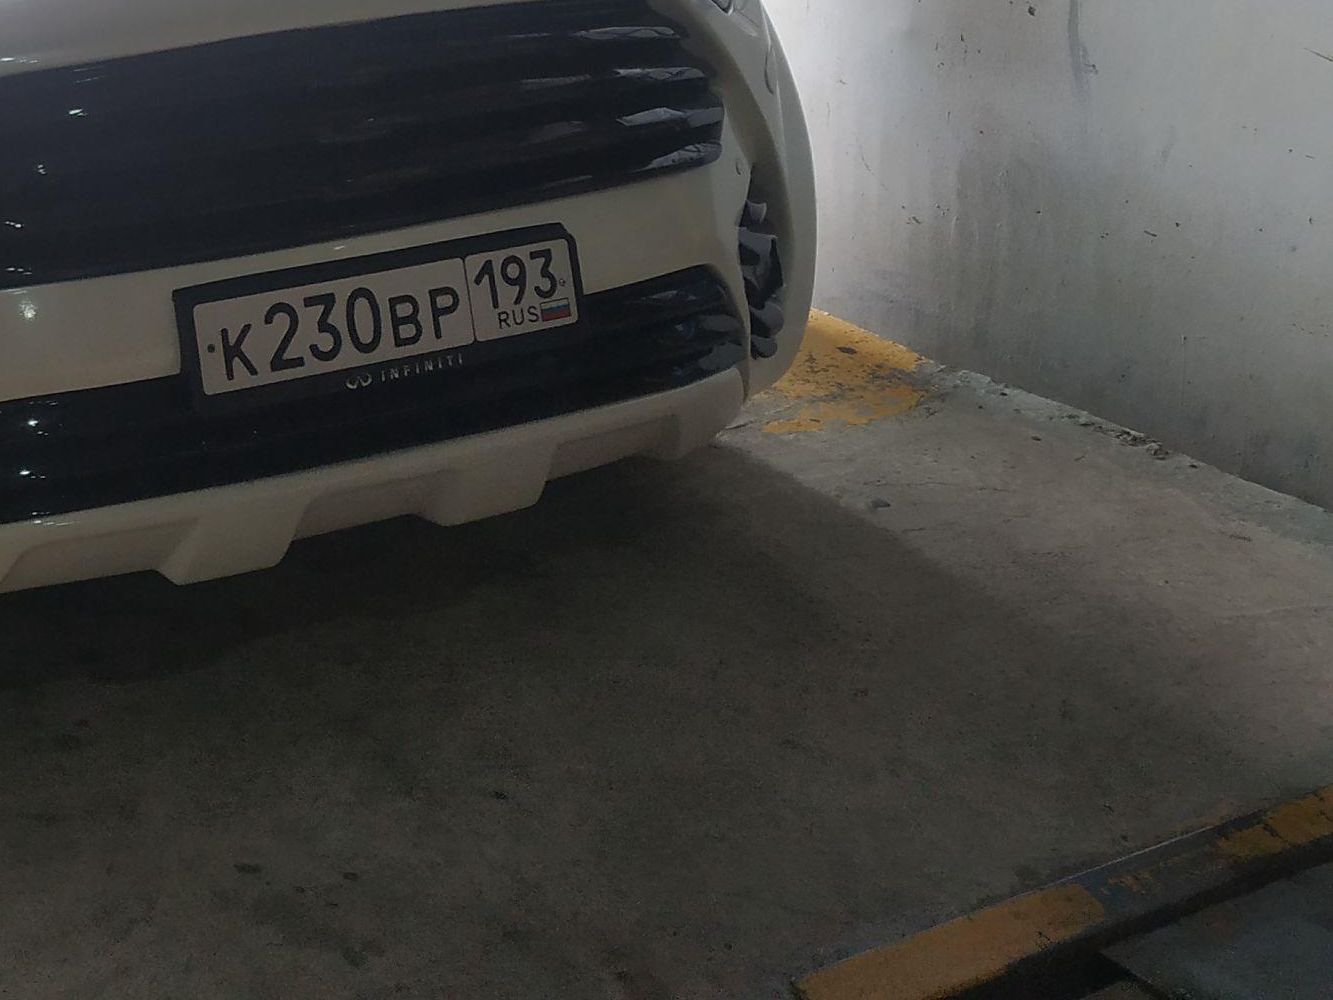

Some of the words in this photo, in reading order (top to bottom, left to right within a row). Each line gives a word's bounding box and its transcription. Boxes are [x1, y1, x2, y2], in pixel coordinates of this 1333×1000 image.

[474, 247, 558, 309] 193
[220, 287, 460, 381] К230ВР
[498, 306, 540, 329] RUS
[380, 352, 465, 382] INFINITI
